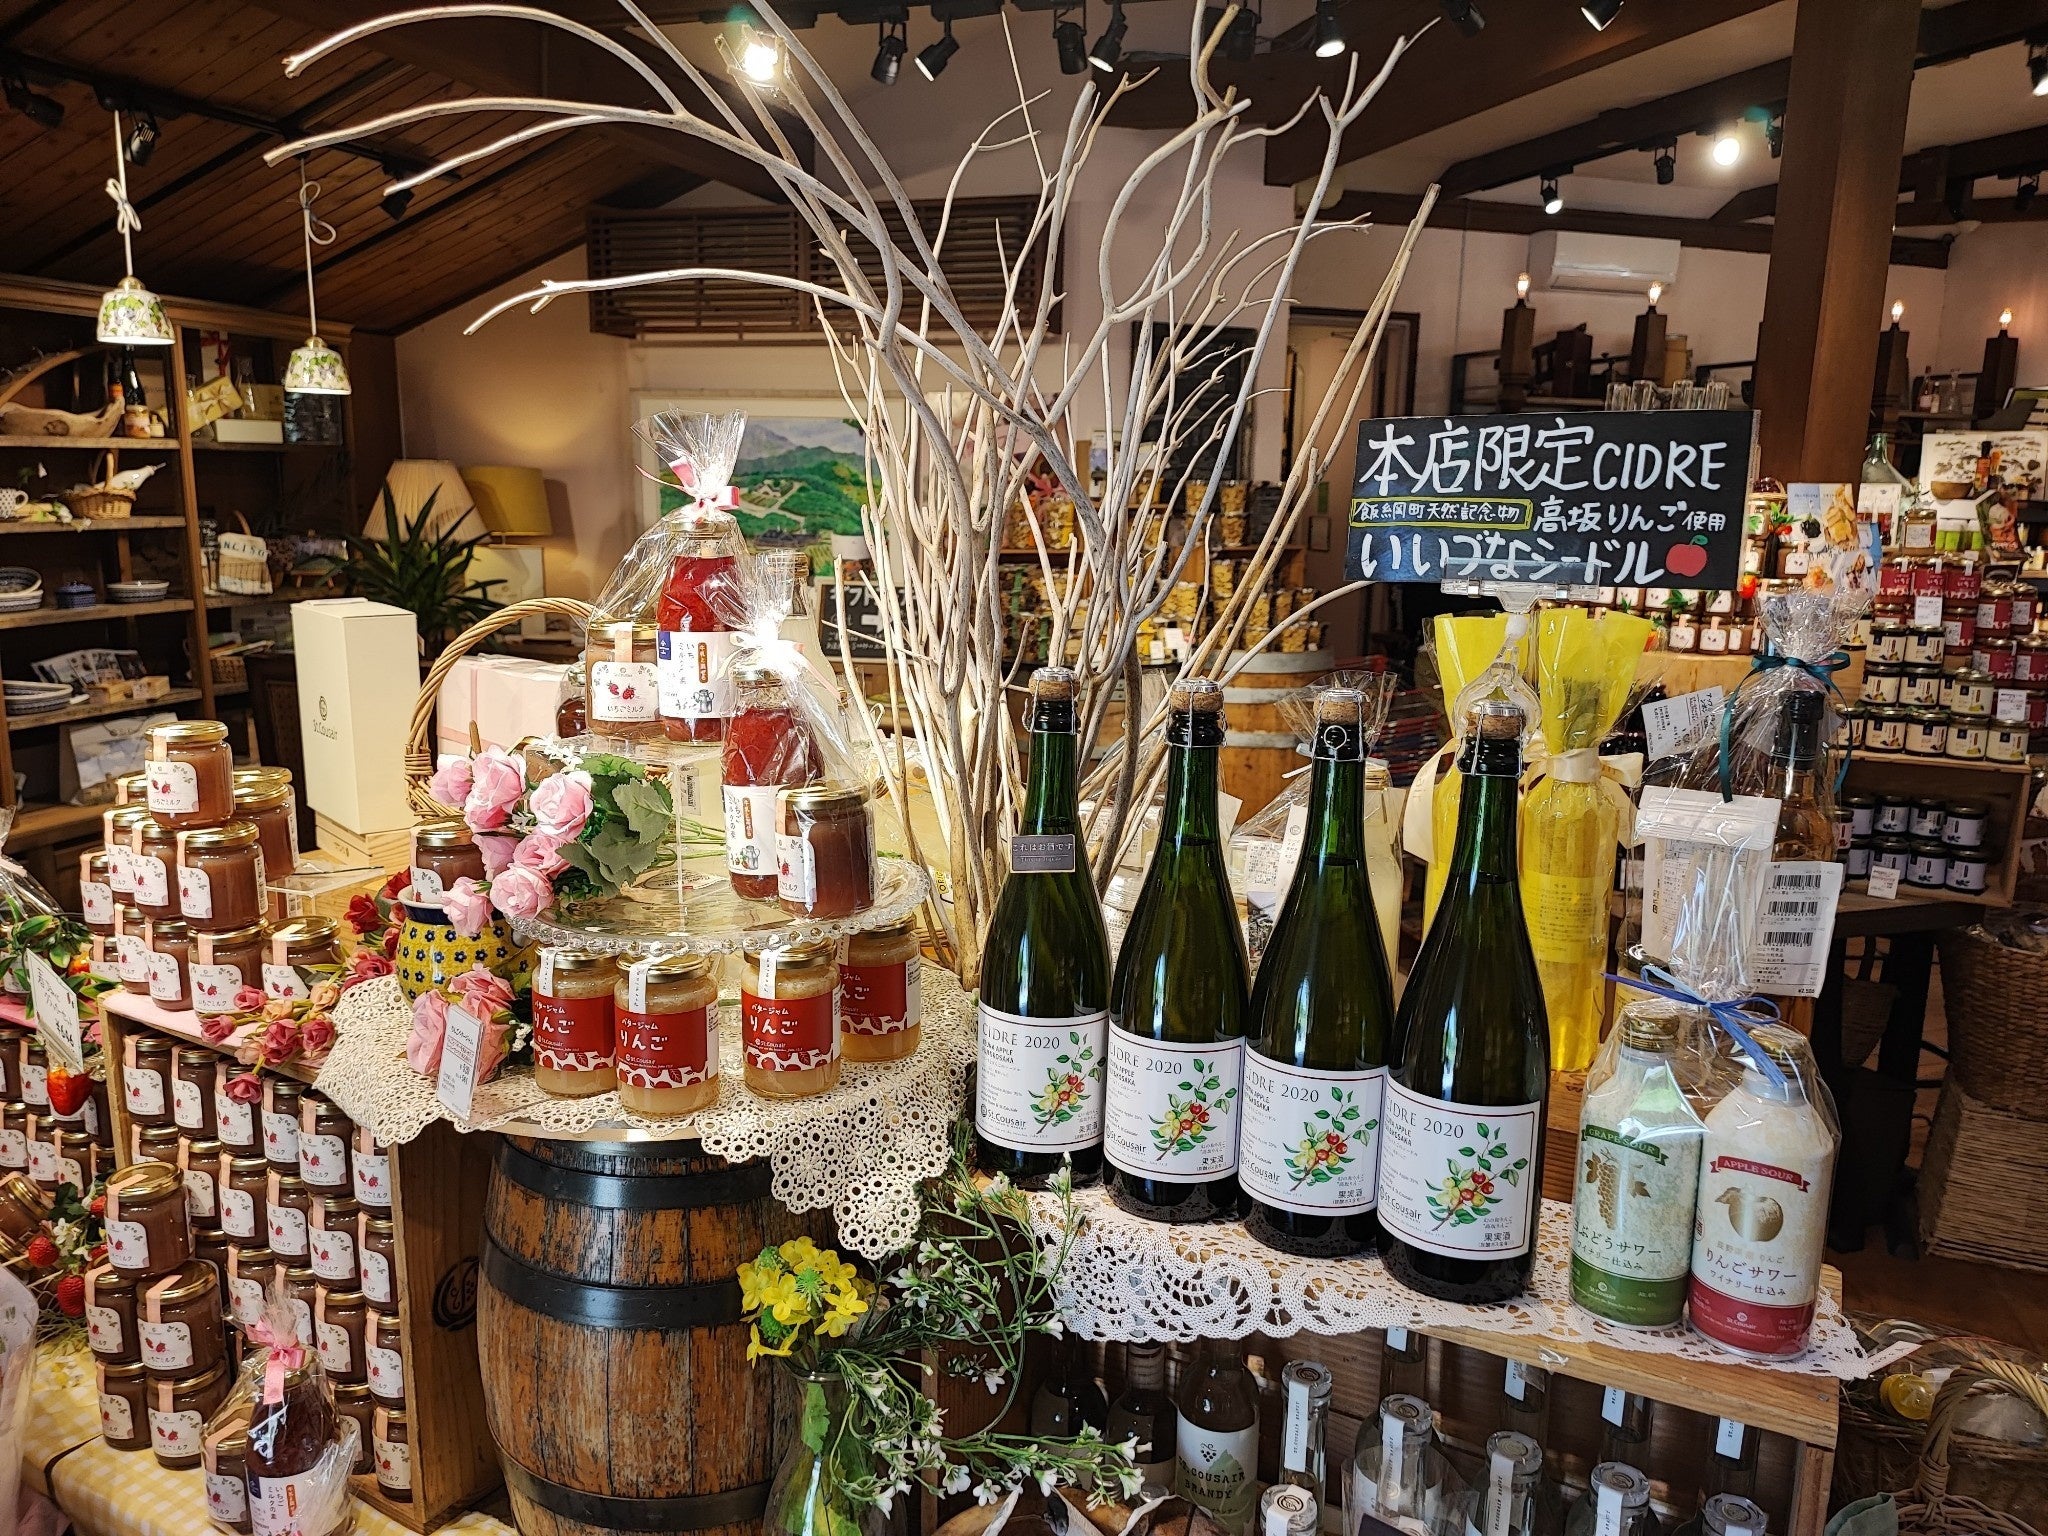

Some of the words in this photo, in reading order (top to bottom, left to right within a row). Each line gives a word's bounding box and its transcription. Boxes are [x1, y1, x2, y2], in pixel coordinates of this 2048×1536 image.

[1360, 530, 1666, 585] いいづなシードル
[607, 705, 645, 714] いちごミルク
[752, 1003, 790, 1016] バタージャム
[534, 1012, 575, 1035] りんご
[621, 1017, 659, 1031] バタージャム
[750, 1014, 799, 1036] りんご
[620, 1029, 668, 1051] りんご
[982, 1023, 1018, 1046] CIDRE
[1024, 1036, 1060, 1050] 2020
[1146, 1058, 1182, 1075] 2020
[1281, 1083, 1319, 1103] 2020
[988, 1109, 1026, 1128] St.Cousair
[1423, 1117, 1464, 1139] 2020
[1588, 1127, 1622, 1144] GRAPE
[1623, 1138, 1656, 1155] SOUR
[1724, 1158, 1760, 1174] APPLE
[1761, 1167, 1794, 1182] SOUR
[1383, 1190, 1422, 1220] St.Cousair
[1484, 1231, 1511, 1242] 果実酒
[1576, 1240, 1645, 1272] ワイナリー仕込み
[1706, 1247, 1797, 1280] りんごサワー
[1710, 1269, 1787, 1296] ワイナリー仕込み
[1726, 1316, 1757, 1331] St.Cousair
[275, 1486, 284, 1507] いちご
[1184, 1479, 1233, 1499] BRANDY
